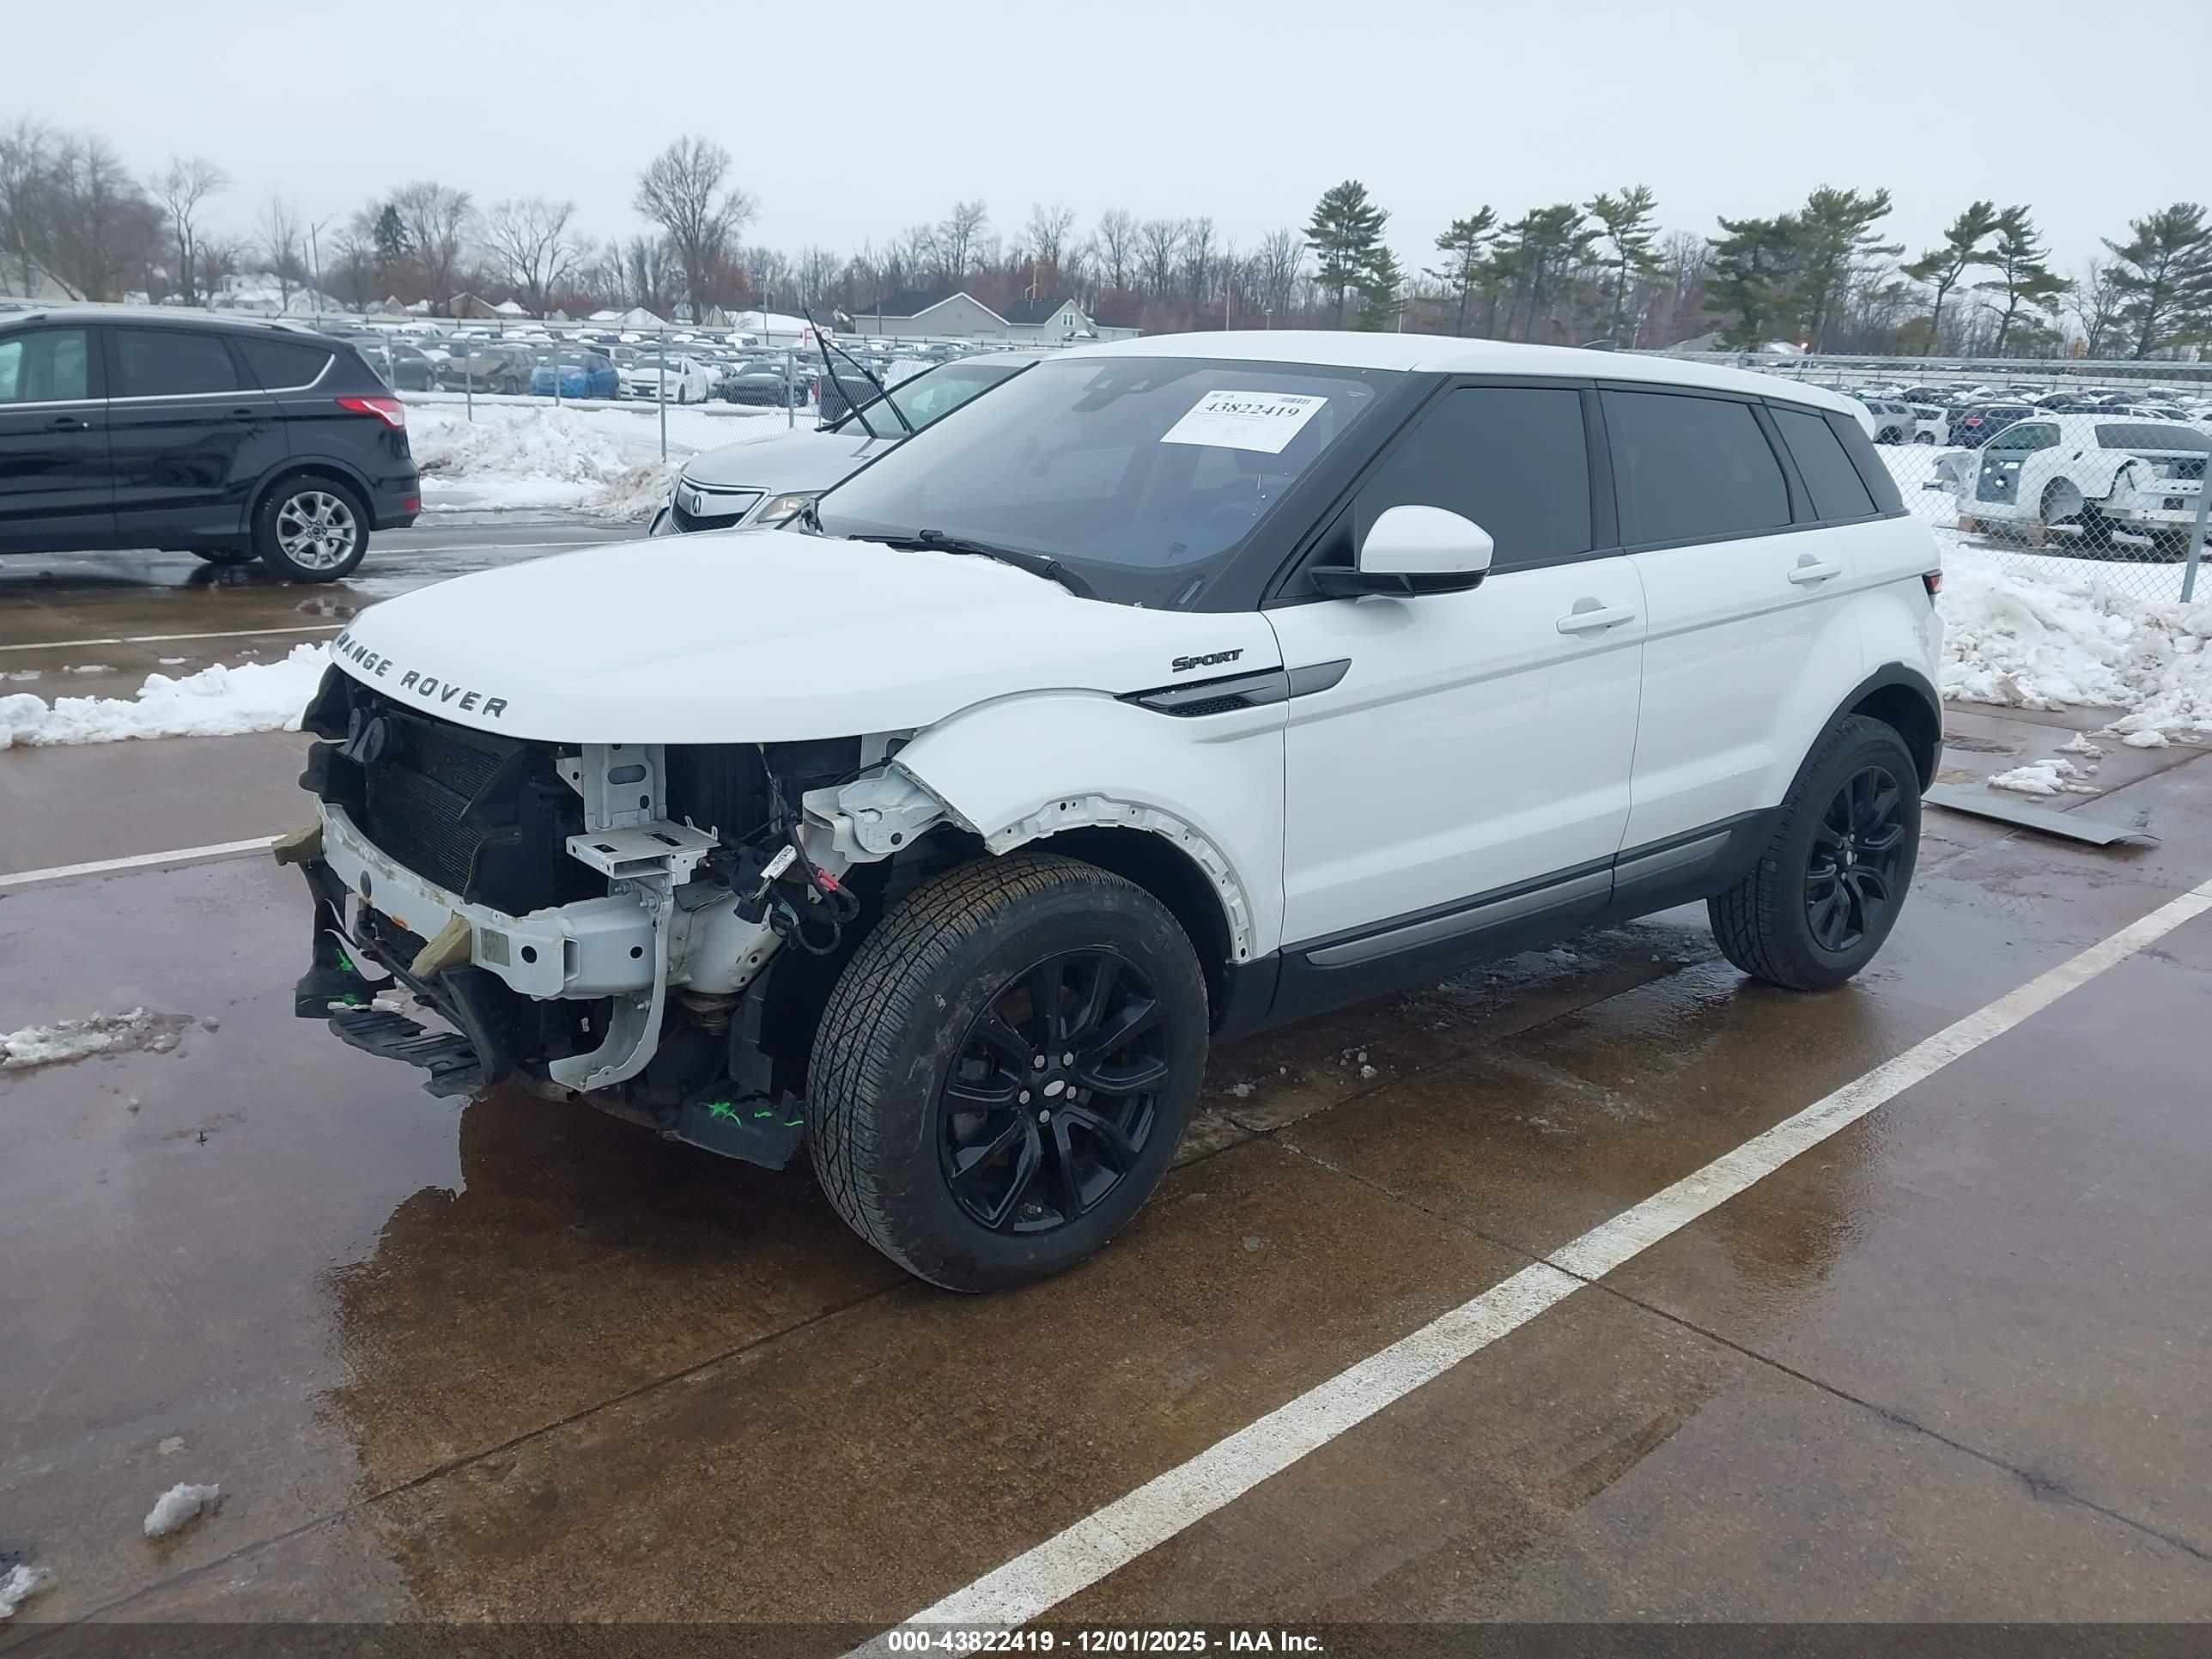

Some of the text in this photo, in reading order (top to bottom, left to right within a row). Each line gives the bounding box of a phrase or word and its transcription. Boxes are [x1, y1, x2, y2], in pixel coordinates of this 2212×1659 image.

[1205, 401, 1301, 418] 43822419
[1172, 648, 1244, 673] SPORT
[336, 632, 508, 718] RANGE ROVER
